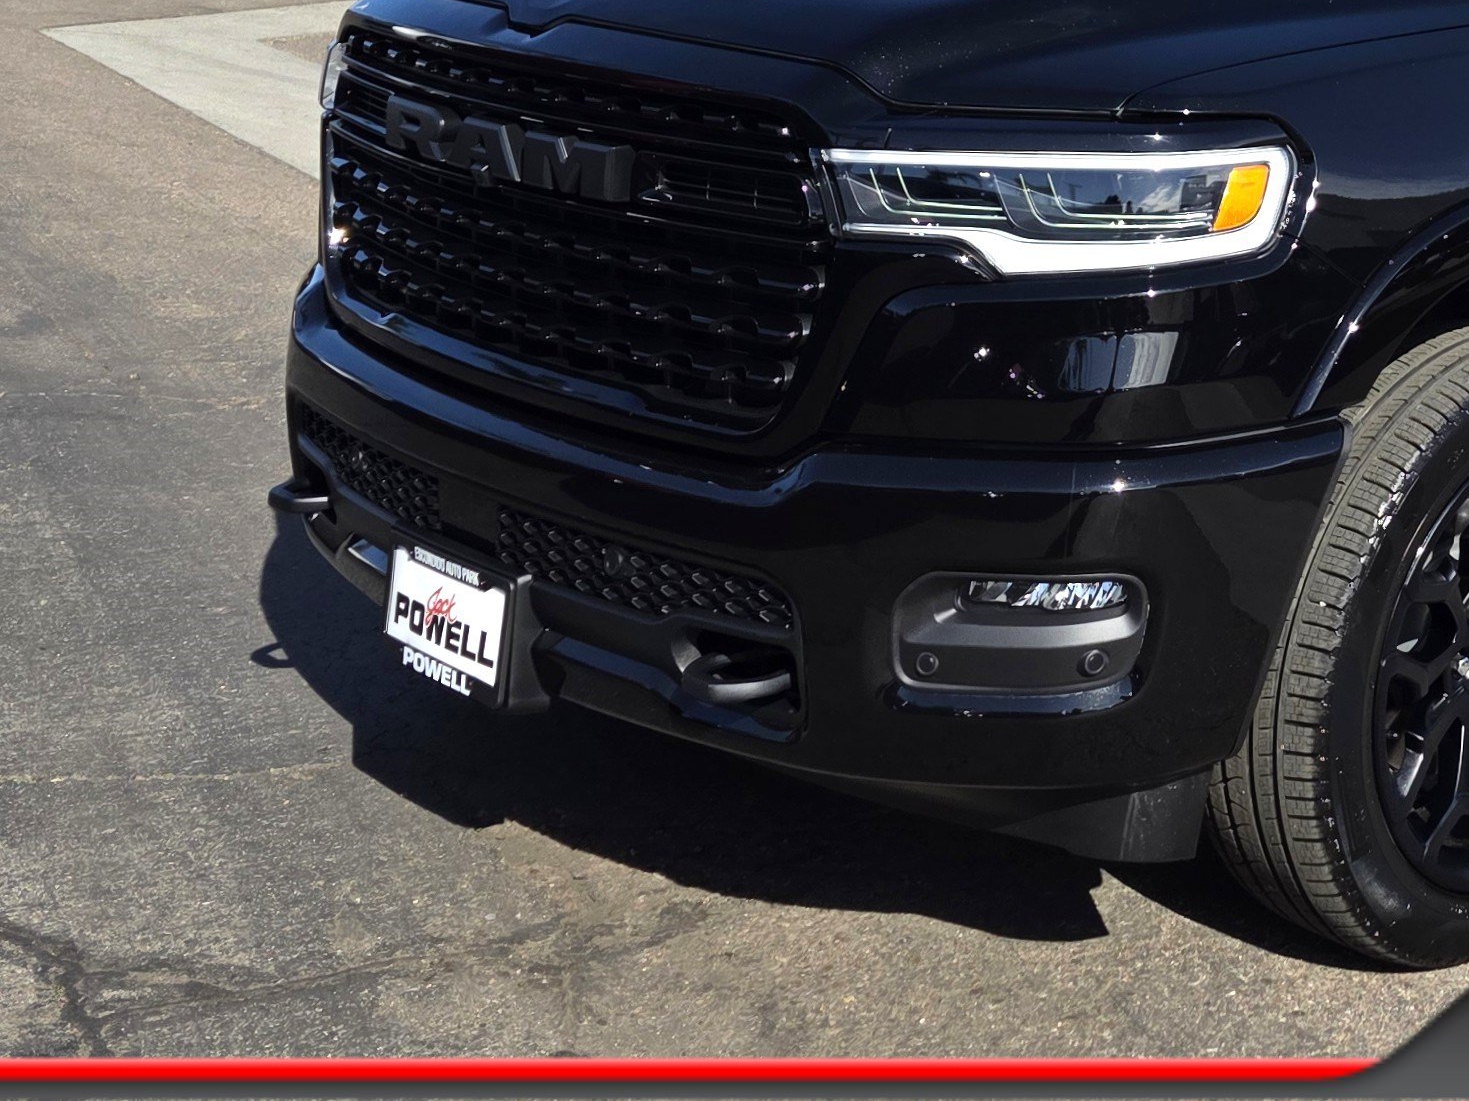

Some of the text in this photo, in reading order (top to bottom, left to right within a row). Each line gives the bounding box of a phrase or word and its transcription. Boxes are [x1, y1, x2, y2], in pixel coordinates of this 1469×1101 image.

[384, 94, 636, 203] RAM
[394, 591, 494, 669] POWELL
[425, 586, 458, 627] Jack
[402, 646, 473, 697] POWELL
